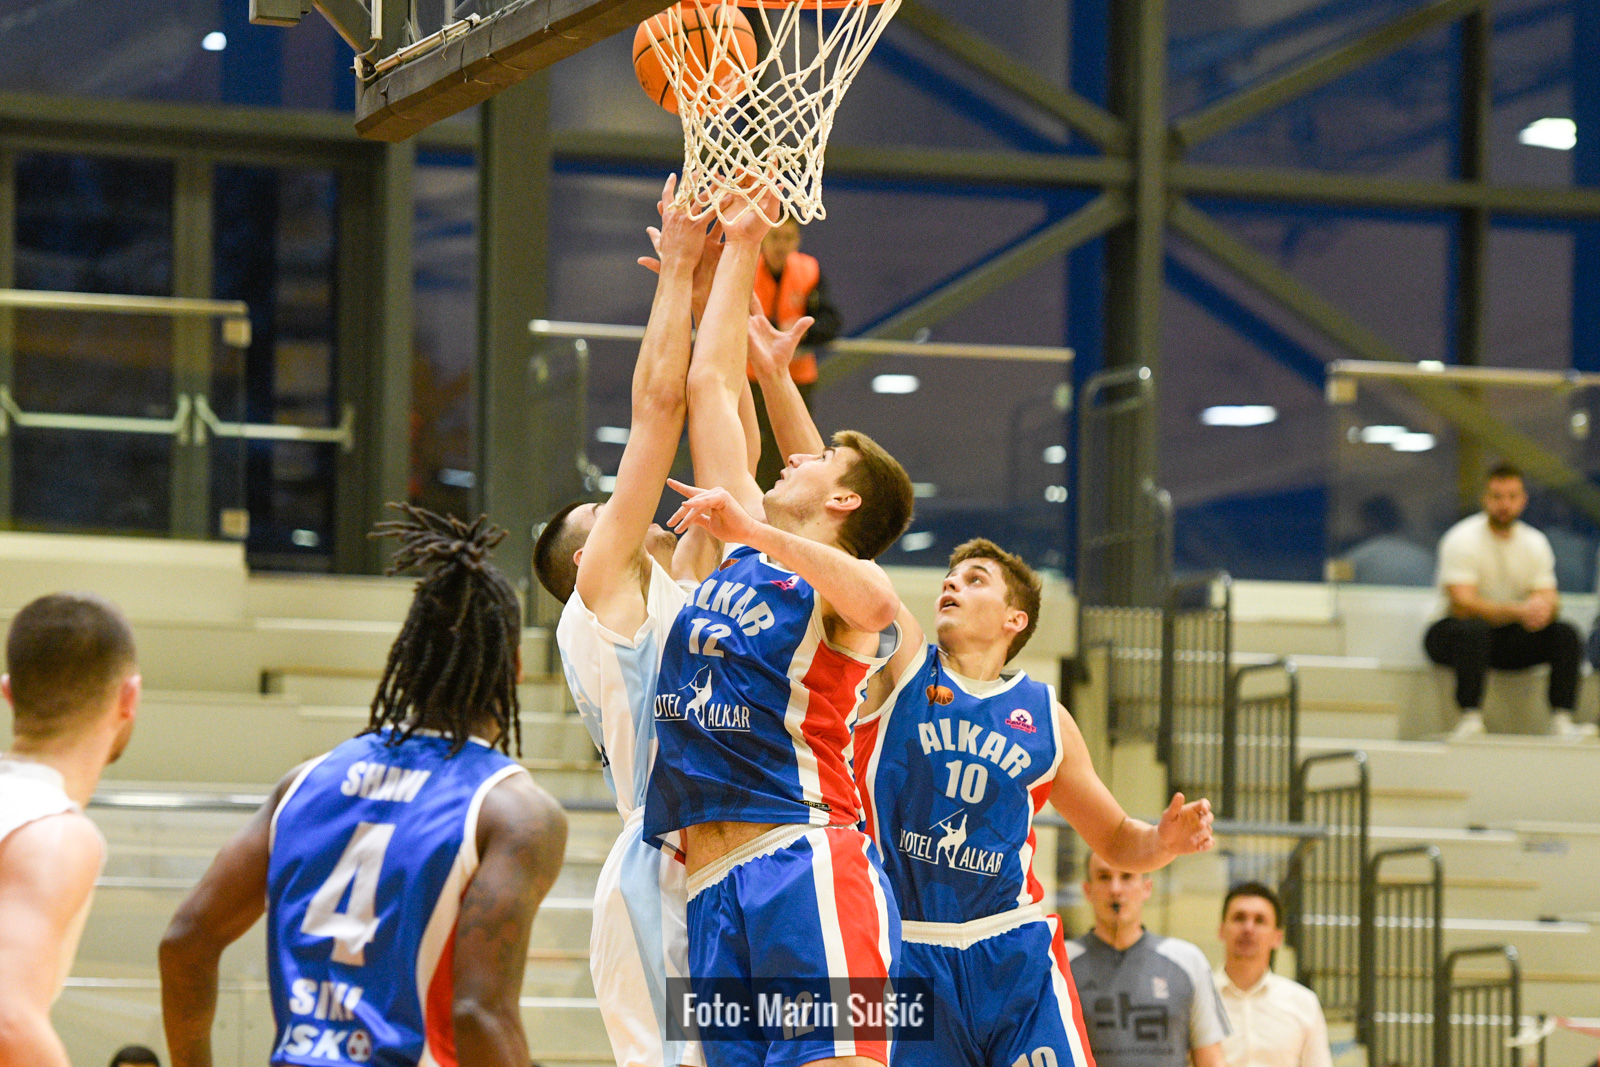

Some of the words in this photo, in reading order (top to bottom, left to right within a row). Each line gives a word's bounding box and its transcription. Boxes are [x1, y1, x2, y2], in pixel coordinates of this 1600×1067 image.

[689, 618, 732, 658] 12
[654, 693, 681, 718] OTEL
[708, 703, 750, 728] ALKAR
[918, 718, 1031, 779] ALKAR
[945, 759, 989, 804] 10
[900, 828, 932, 859] HOTEL
[959, 846, 1004, 874] ALKAR
[301, 821, 396, 966] 4
[783, 991, 815, 1040] 12
[278, 1023, 348, 1060] SK
